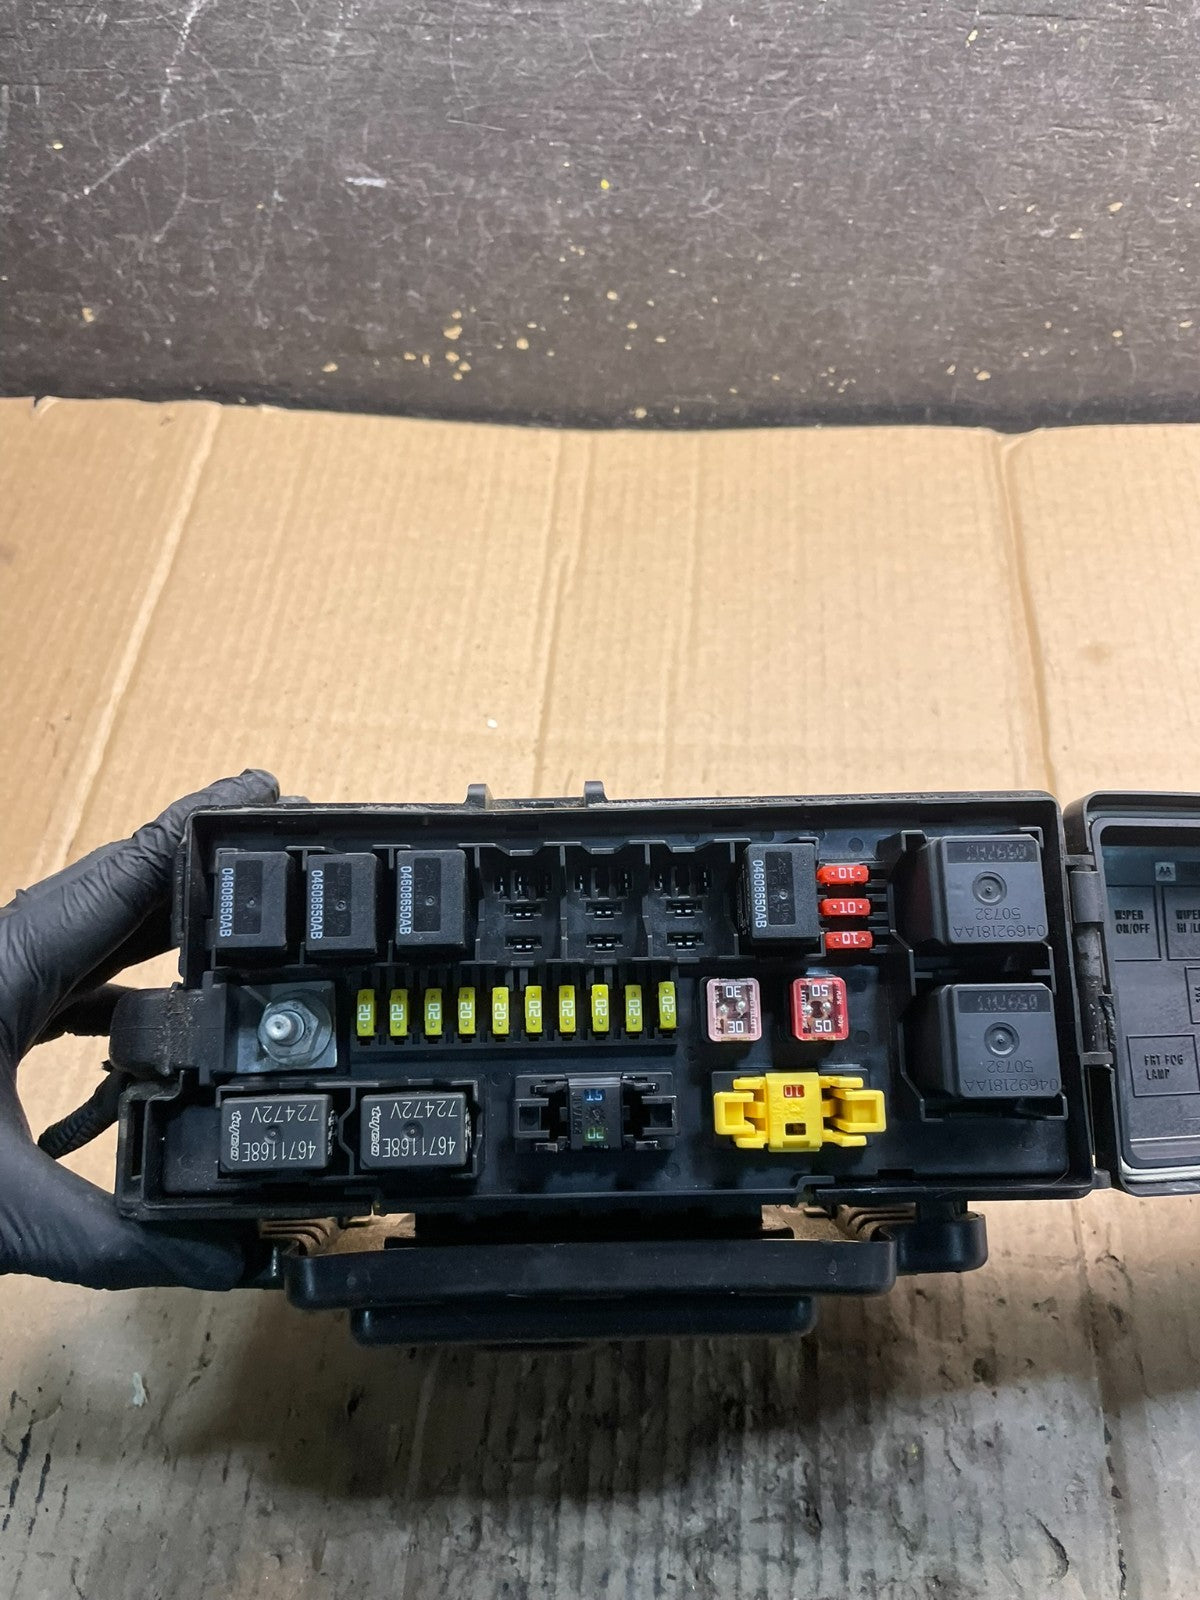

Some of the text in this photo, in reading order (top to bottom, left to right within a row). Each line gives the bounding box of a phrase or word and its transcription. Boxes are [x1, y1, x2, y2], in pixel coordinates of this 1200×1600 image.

[838, 867, 855, 879] 10
[219, 867, 234, 937] 04608650AB
[399, 865, 412, 935] 04608650AB
[752, 859, 767, 929] 04608650AB
[310, 869, 323, 940] 04608650AB
[839, 901, 856, 913] 10
[975, 906, 1021, 921] 50732
[1114, 909, 1144, 921] WIPER
[1175, 909, 1200, 920] WIPE
[952, 923, 1046, 939] 04692181AA
[1115, 922, 1150, 935] ON/OFF
[842, 932, 859, 945] 10
[725, 985, 742, 998] 30
[811, 984, 829, 997] 50
[358, 1003, 370, 1021] 20
[392, 1003, 404, 1021] 20
[428, 1002, 440, 1020] 20
[460, 1001, 472, 1019] 20
[495, 1002, 507, 1020] 20
[528, 1000, 541, 1017] 20
[561, 999, 574, 1017] 20
[595, 998, 607, 1016] 20
[628, 999, 640, 1016] 20
[662, 996, 674, 1013] 20
[727, 1020, 744, 1033] 30
[814, 1019, 832, 1032] 50
[986, 1059, 1034, 1074] 50732
[1144, 1054, 1184, 1066] FRT FOG
[1145, 1068, 1170, 1080] LAMP
[784, 1085, 804, 1097] 10
[963, 1077, 1059, 1092] 04692181AA
[249, 1103, 319, 1123] 72472V
[389, 1100, 458, 1119] 72472V
[230, 1109, 242, 1161] tyco
[370, 1105, 381, 1157] tyco
[241, 1140, 317, 1162] 4671168E
[382, 1136, 456, 1158] 4671168E
